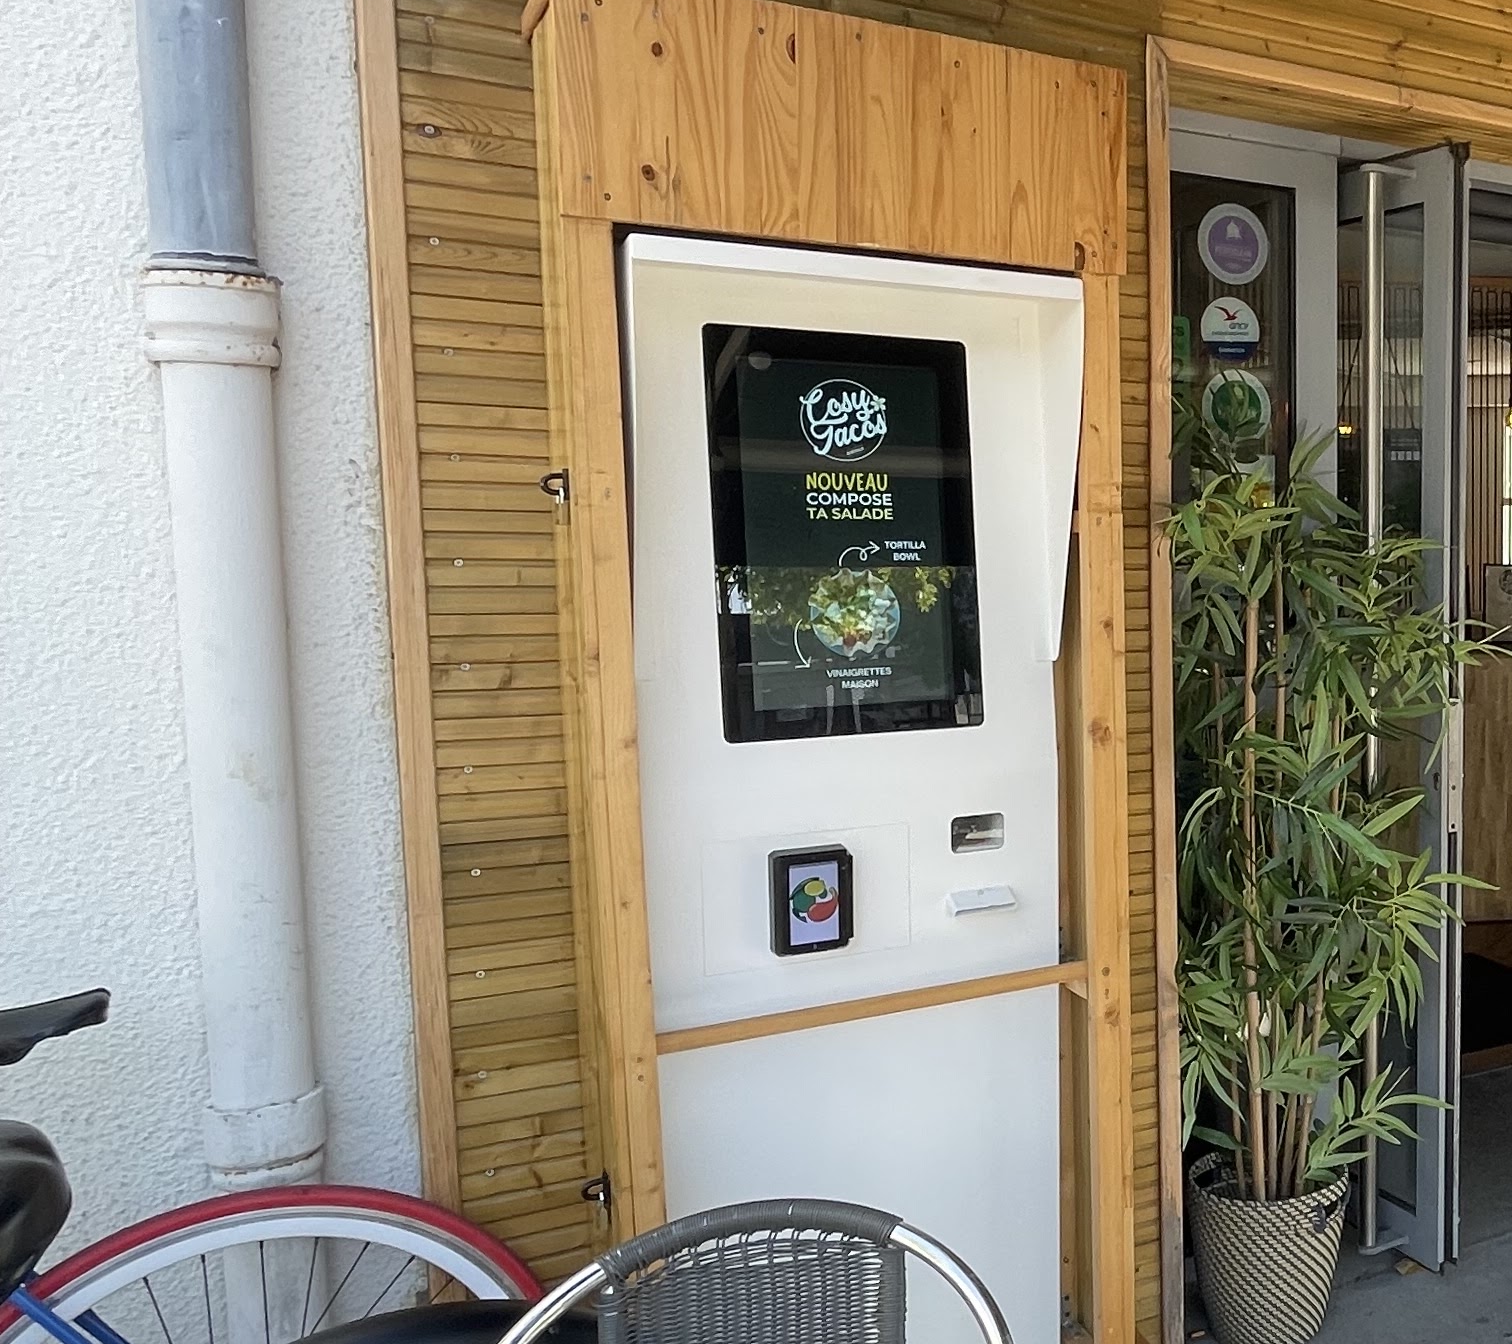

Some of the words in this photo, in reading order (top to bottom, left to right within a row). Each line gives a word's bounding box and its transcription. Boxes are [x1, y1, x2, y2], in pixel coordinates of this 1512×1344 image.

[799, 388, 874, 425] Cosy
[810, 413, 887, 455] Tacos
[805, 472, 888, 492] NOUVEAU
[805, 492, 893, 506] COMPOSE
[806, 507, 828, 520] TA
[831, 507, 894, 520] SALADE
[884, 540, 927, 550] TORTILLA
[892, 552, 922, 561] BOWL
[826, 666, 893, 678] VINAIGRETTES
[841, 679, 880, 689] MAISON
